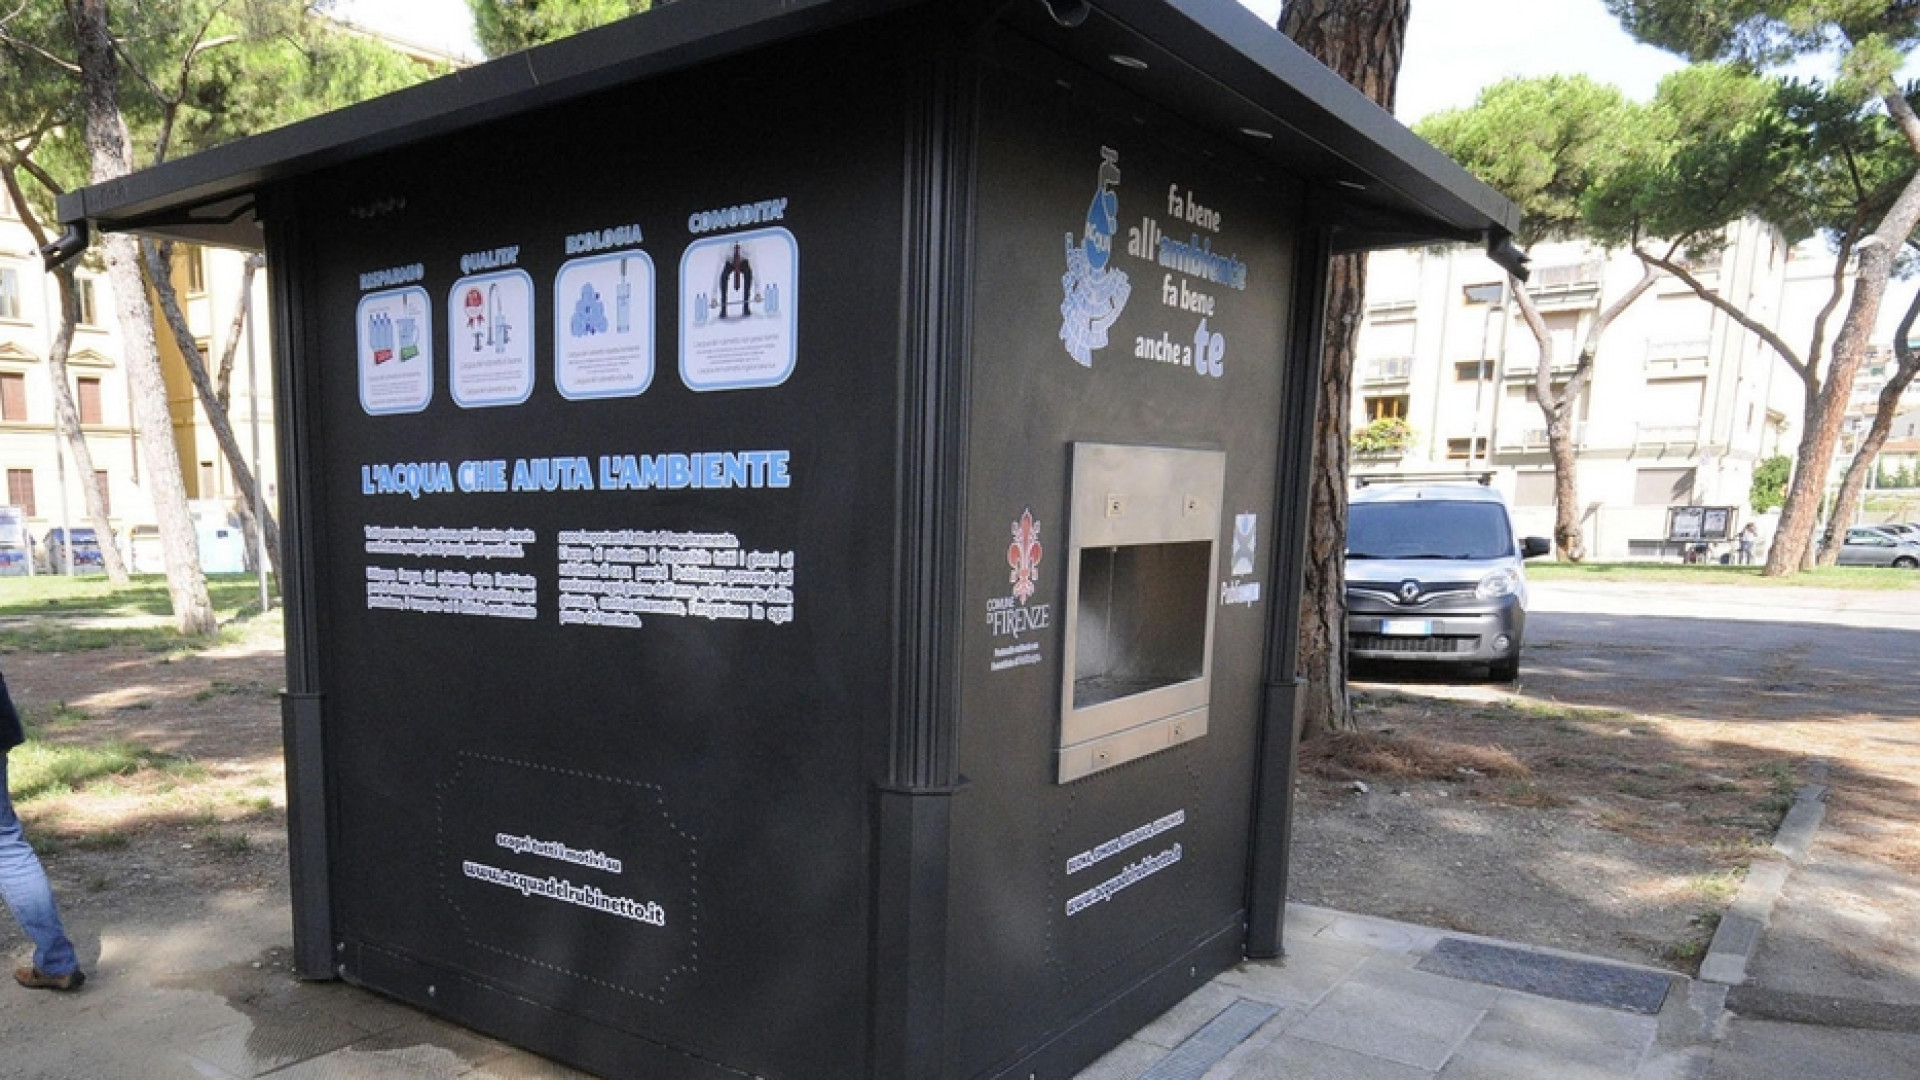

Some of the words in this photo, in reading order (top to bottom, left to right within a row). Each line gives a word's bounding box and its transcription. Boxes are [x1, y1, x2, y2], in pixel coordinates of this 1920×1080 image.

[1168, 183, 1183, 219] fa
[1185, 191, 1221, 232] bene
[565, 223, 644, 255] ECOLOGIA
[1162, 273, 1178, 307] fa
[1180, 279, 1215, 317] bene
[1134, 331, 1181, 365] anche
[1181, 345, 1191, 366] a
[1194, 317, 1225, 378] te
[361, 463, 455, 500] L'ACQUA
[457, 459, 508, 493] CHE
[511, 456, 595, 491] AIUTA
[599, 450, 791, 491] L'AMBIENTE
[993, 604, 1050, 639] FIRENZE
[495, 832, 531, 854] scopri
[564, 848, 606, 870] motivi
[462, 860, 666, 927] www.acquadelrubinetto.it
